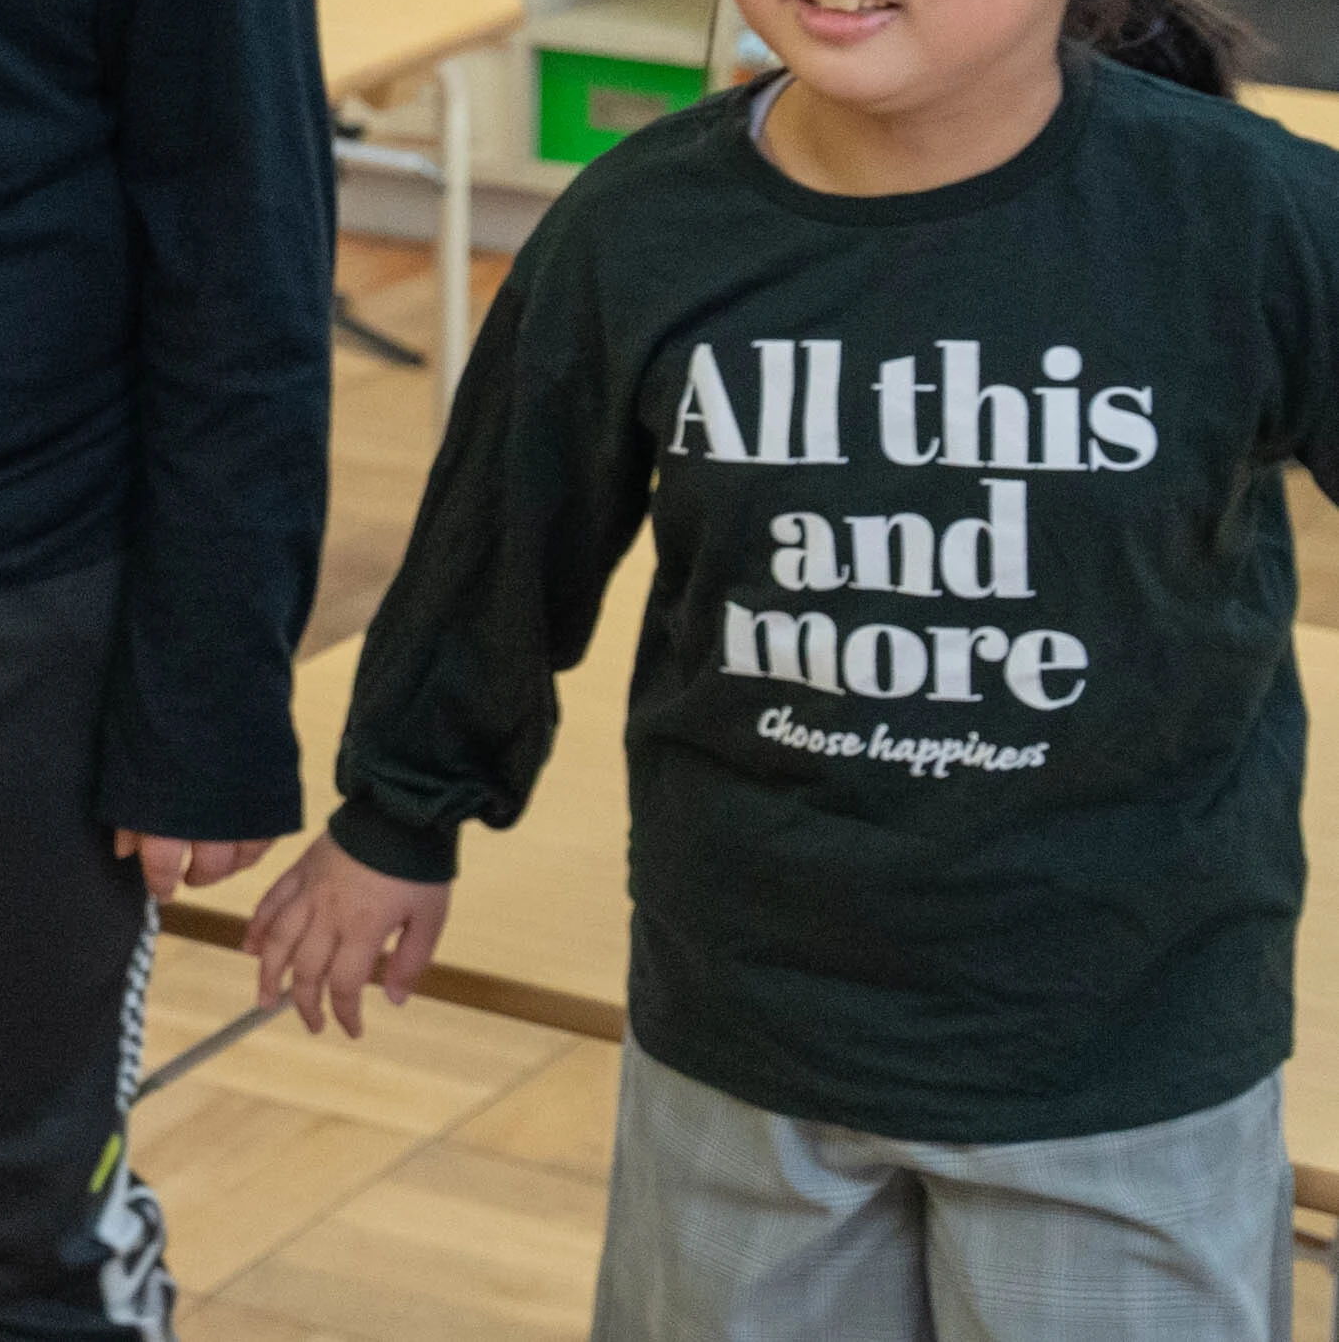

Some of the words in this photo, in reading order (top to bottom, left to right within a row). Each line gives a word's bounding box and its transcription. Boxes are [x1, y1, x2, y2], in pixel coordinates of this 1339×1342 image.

[668, 339, 849, 465] All
[871, 339, 1158, 472] this
[770, 478, 1036, 598] and
[721, 601, 1088, 711] more
[867, 723, 1050, 778] happiness
